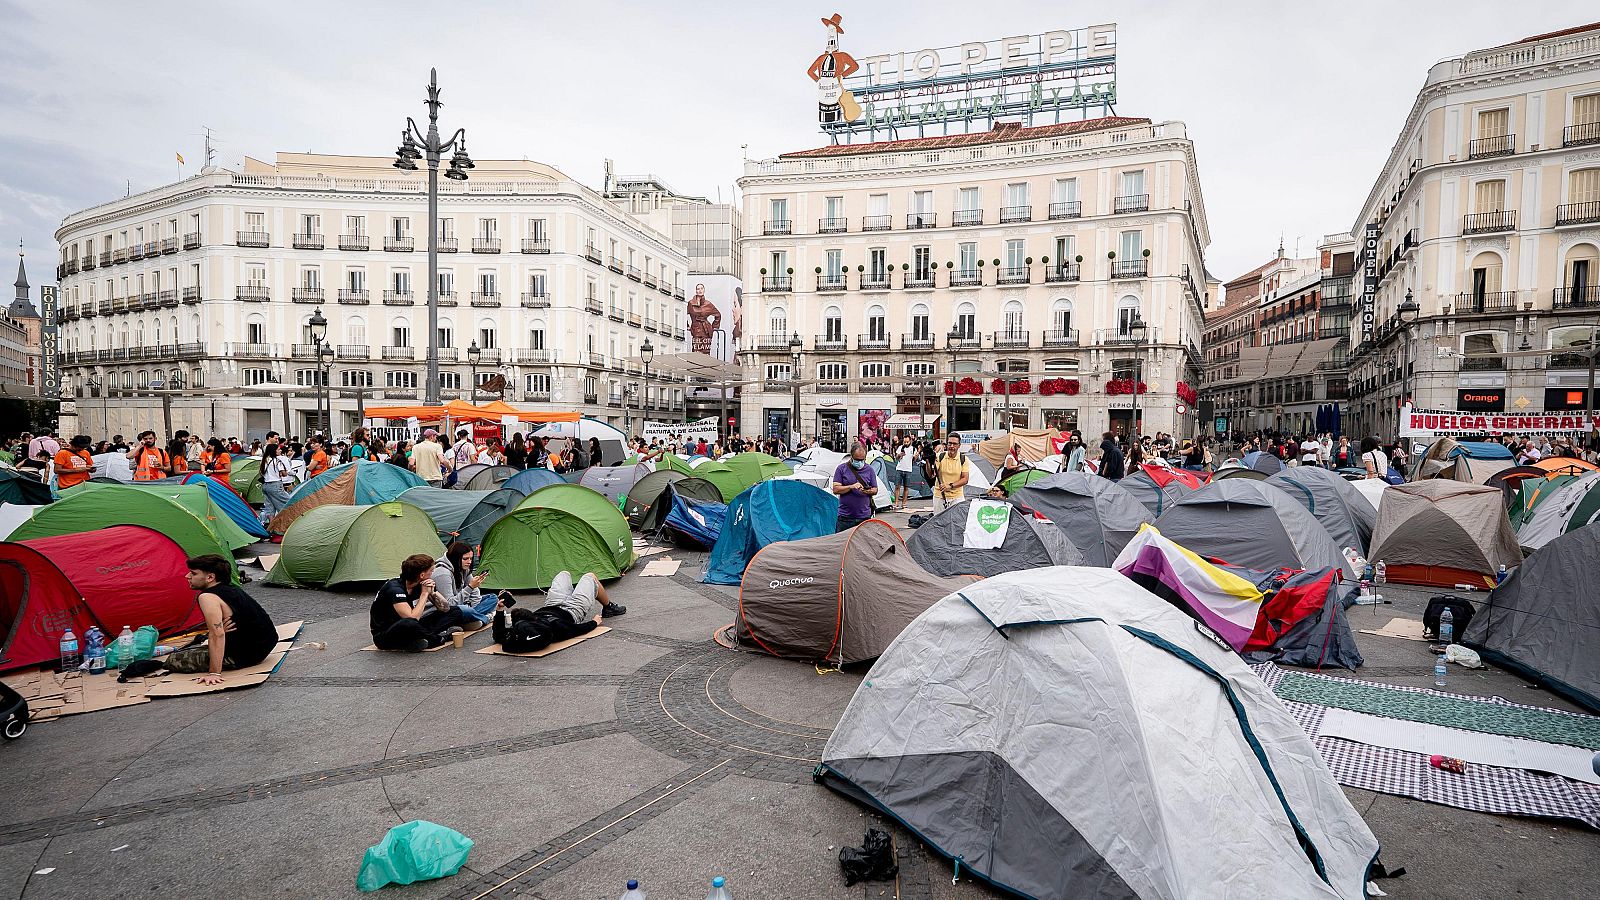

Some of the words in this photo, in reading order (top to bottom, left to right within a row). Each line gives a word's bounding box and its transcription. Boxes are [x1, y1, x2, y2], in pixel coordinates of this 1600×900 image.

[866, 49, 940, 85] TIO
[960, 23, 1117, 75] PEPE
[895, 89, 909, 99] DE
[1367, 229, 1378, 277] HOTEL
[43, 287, 55, 327] HOTEL
[1363, 284, 1375, 341] EUROPA
[43, 332, 56, 387] MODERNO
[1464, 394, 1499, 402] Orange
[371, 427, 411, 441] CONTRA
[1410, 415, 1487, 429] HUELGA
[1492, 416, 1585, 429] GENERAL
[769, 577, 814, 589] Quechua
